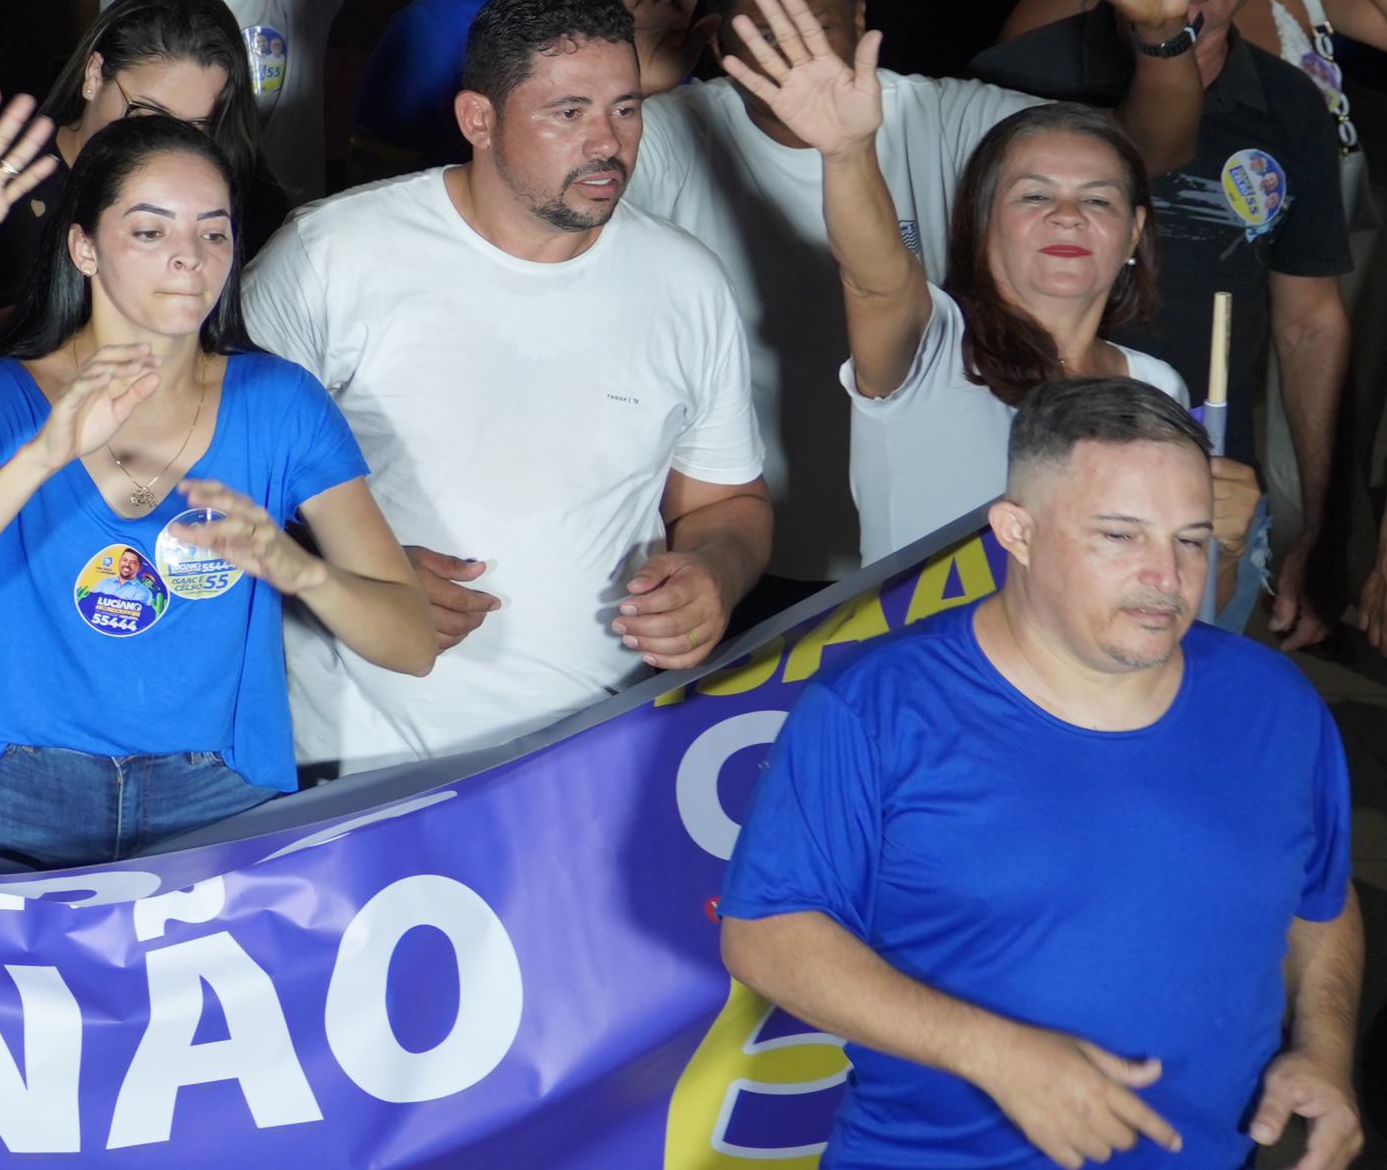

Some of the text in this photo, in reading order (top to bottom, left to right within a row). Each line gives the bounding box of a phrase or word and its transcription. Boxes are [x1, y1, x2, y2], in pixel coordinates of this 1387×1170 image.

[174, 582, 202, 592] CELSO
[202, 574, 229, 591] 55
[97, 597, 143, 612] LUCIANO
[91, 613, 137, 632] 55444
